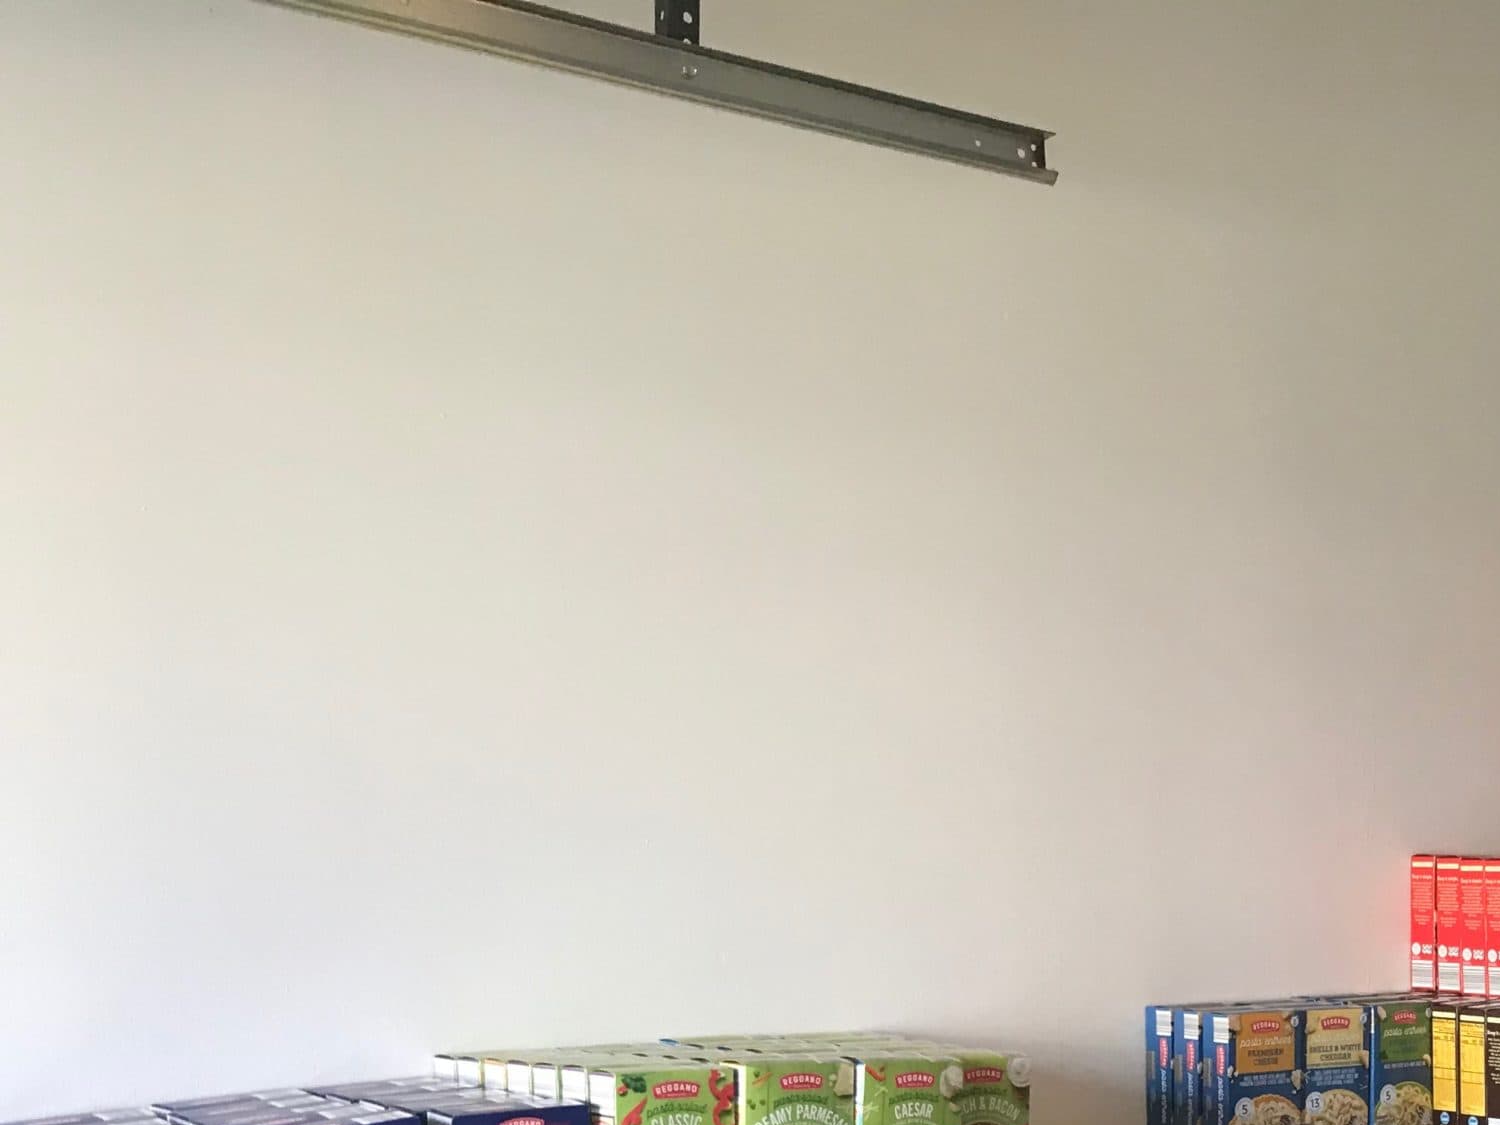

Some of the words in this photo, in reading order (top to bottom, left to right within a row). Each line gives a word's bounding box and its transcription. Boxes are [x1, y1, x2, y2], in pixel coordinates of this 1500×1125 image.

[782, 1074, 822, 1086] REGGANO
[897, 1075, 933, 1085] REGGANO
[656, 1083, 698, 1095] REGGANO
[1385, 1090, 1391, 1100] 5
[989, 1096, 1020, 1121] BACON
[1311, 1097, 1320, 1109] 13
[894, 1102, 934, 1120] CAESAR
[1241, 1104, 1248, 1116] 5
